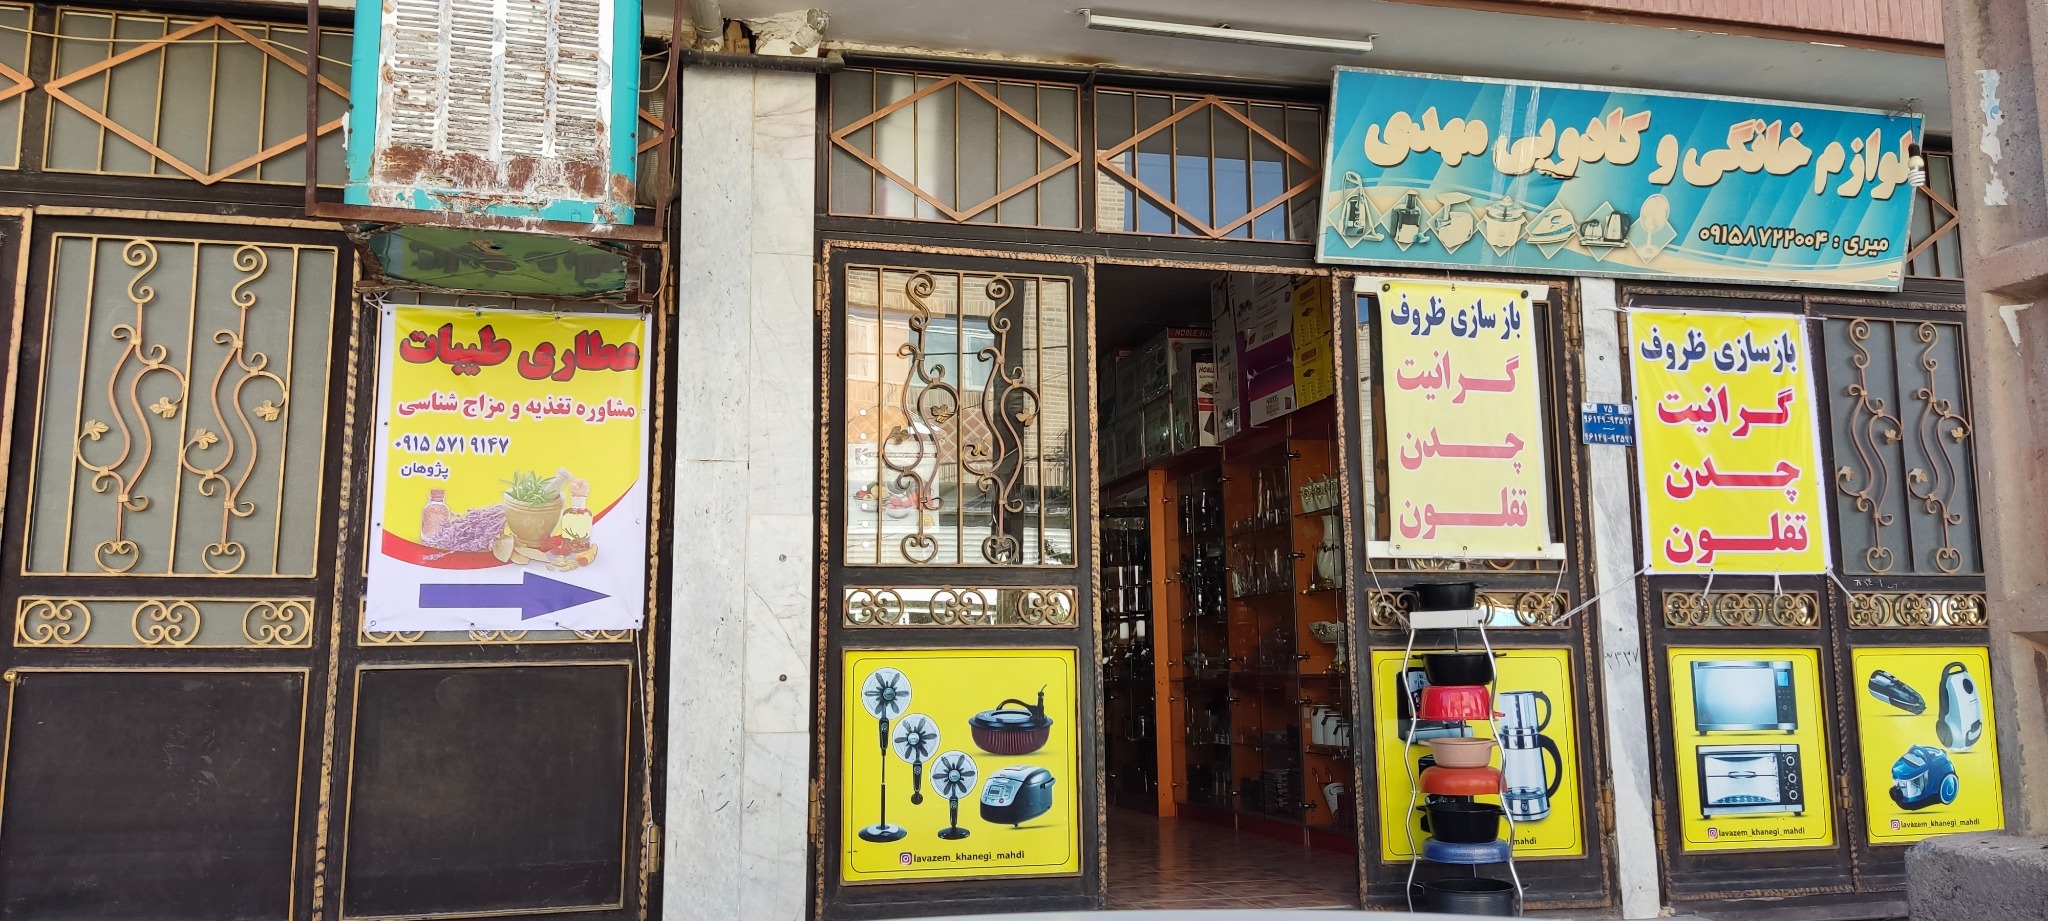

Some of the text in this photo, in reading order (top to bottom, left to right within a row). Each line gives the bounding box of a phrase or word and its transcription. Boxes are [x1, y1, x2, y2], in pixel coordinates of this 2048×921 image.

[1365, 106, 1912, 200] لوازم خانگی و کادویی مهدی
[1699, 223, 1829, 251] ۰۹۱۵۸۷۲۲۰۰۴
[1843, 235, 1890, 257] میری
[1391, 294, 1446, 336] ظروف
[399, 322, 640, 381] عطاری طیبات
[1641, 327, 1707, 371] ظروف
[1396, 350, 1520, 404] گرانیت
[399, 392, 635, 422] مشاوره تغذیه و مزاج شناسی
[1657, 385, 1794, 437] گرانیت
[395, 434, 509, 454] ۰۹۱۵ ۵۷۱ ۹۱۴۷
[1400, 426, 1525, 475] چدن
[400, 462, 449, 480] پژوهان
[1666, 457, 1800, 502] چدن
[1399, 486, 1528, 540] تفلون
[1666, 512, 1808, 564] تفلون
[1718, 826, 1806, 838] lavazem_khanegi_mahdi
[913, 850, 1025, 863] lavazem_khanegi_mahdi
